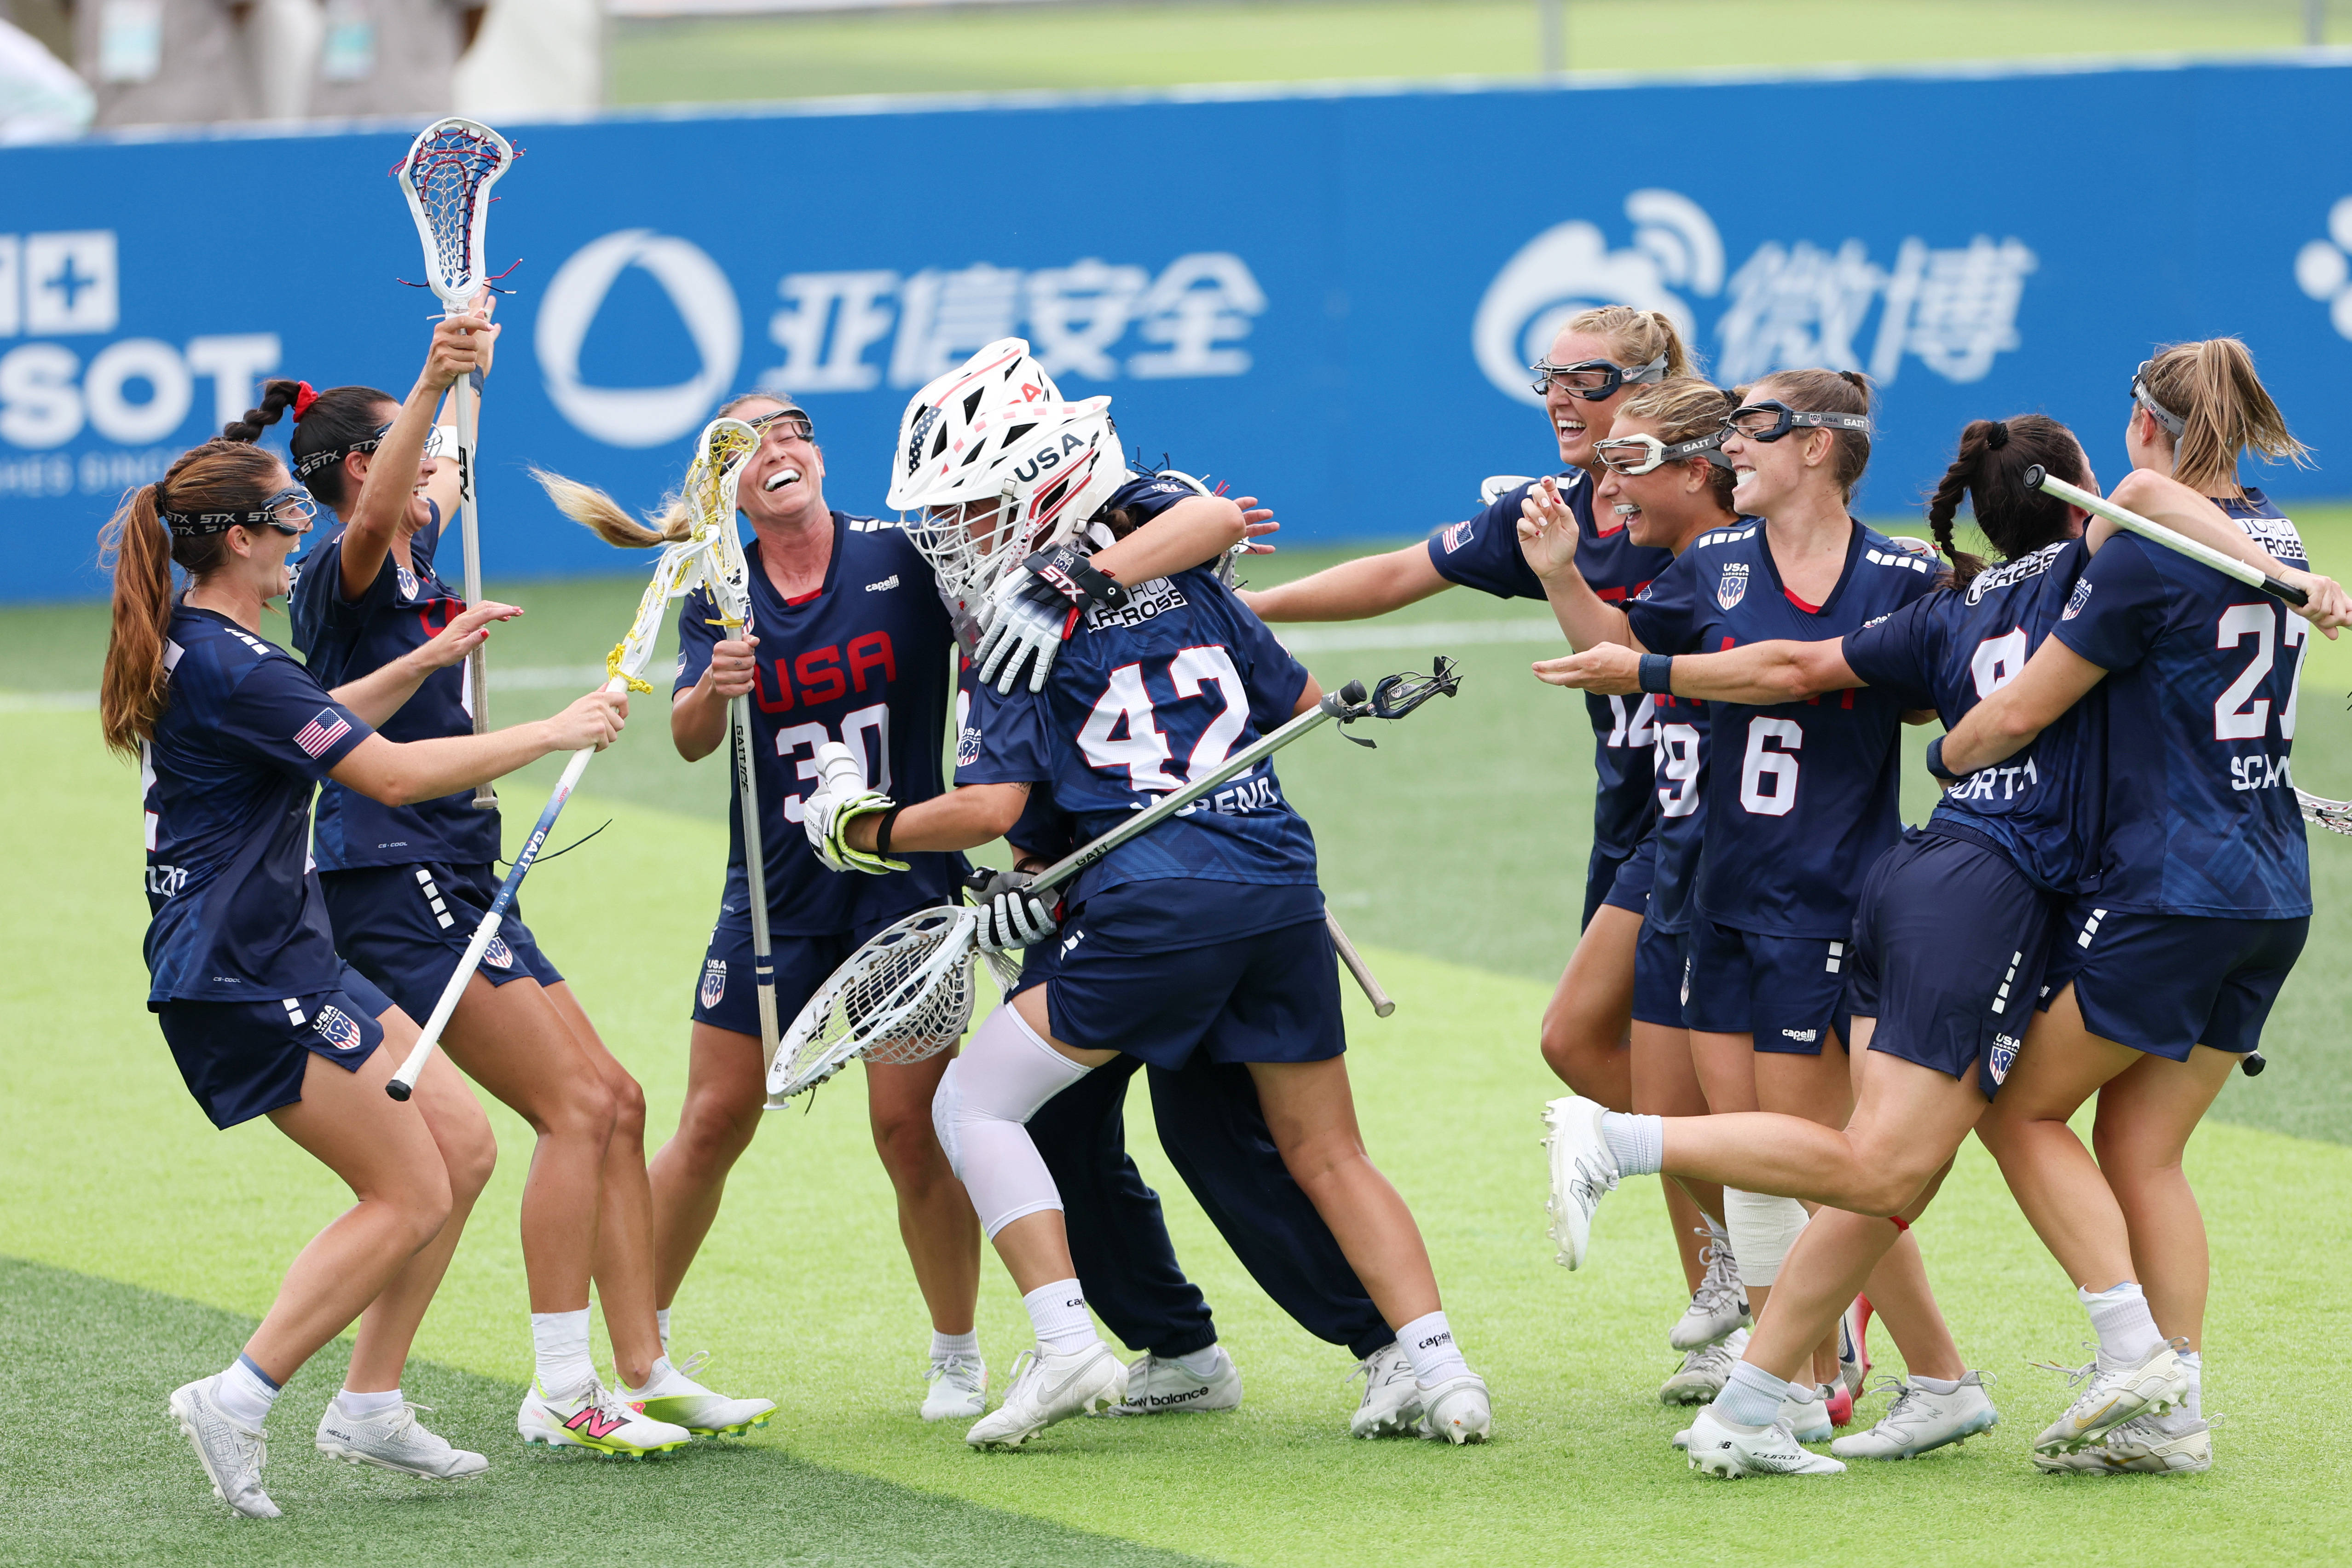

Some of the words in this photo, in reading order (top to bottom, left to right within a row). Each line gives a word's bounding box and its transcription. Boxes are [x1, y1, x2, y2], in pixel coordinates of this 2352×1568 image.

[1714, 233, 2038, 386] 微博
[757, 252, 1268, 393] 亚信安全
[2136, 385, 2146, 400] AIT
[1844, 418, 1865, 428] GAIT
[1014, 433, 1085, 482] USA
[1682, 439, 1709, 452] GAIT
[167, 512, 189, 525] STX
[200, 513, 236, 524] STX
[248, 512, 269, 523] ST
[1060, 549, 1075, 564] USA
[1723, 563, 1749, 573] USA
[865, 574, 899, 592] capelli
[1039, 565, 1086, 603] STX
[1128, 577, 1169, 602] RLD
[754, 631, 896, 714] USA
[1076, 644, 1254, 793] 42
[736, 725, 745, 763] GAIT
[775, 703, 892, 824] 30
[1740, 716, 1803, 816] 6
[519, 830, 547, 873] GAIT
[1076, 841, 1108, 867] GAIT
[707, 959, 727, 970] USA
[312, 1005, 335, 1030] USA
[318, 1007, 339, 1034] LACROSSE
[1782, 1029, 1816, 1040] capelli
[1996, 1032, 2020, 1049] USA
[1150, 1387, 1209, 1406] balance
[326, 1429, 351, 1441] HELIA
[1752, 1452, 1801, 1460] FURON
